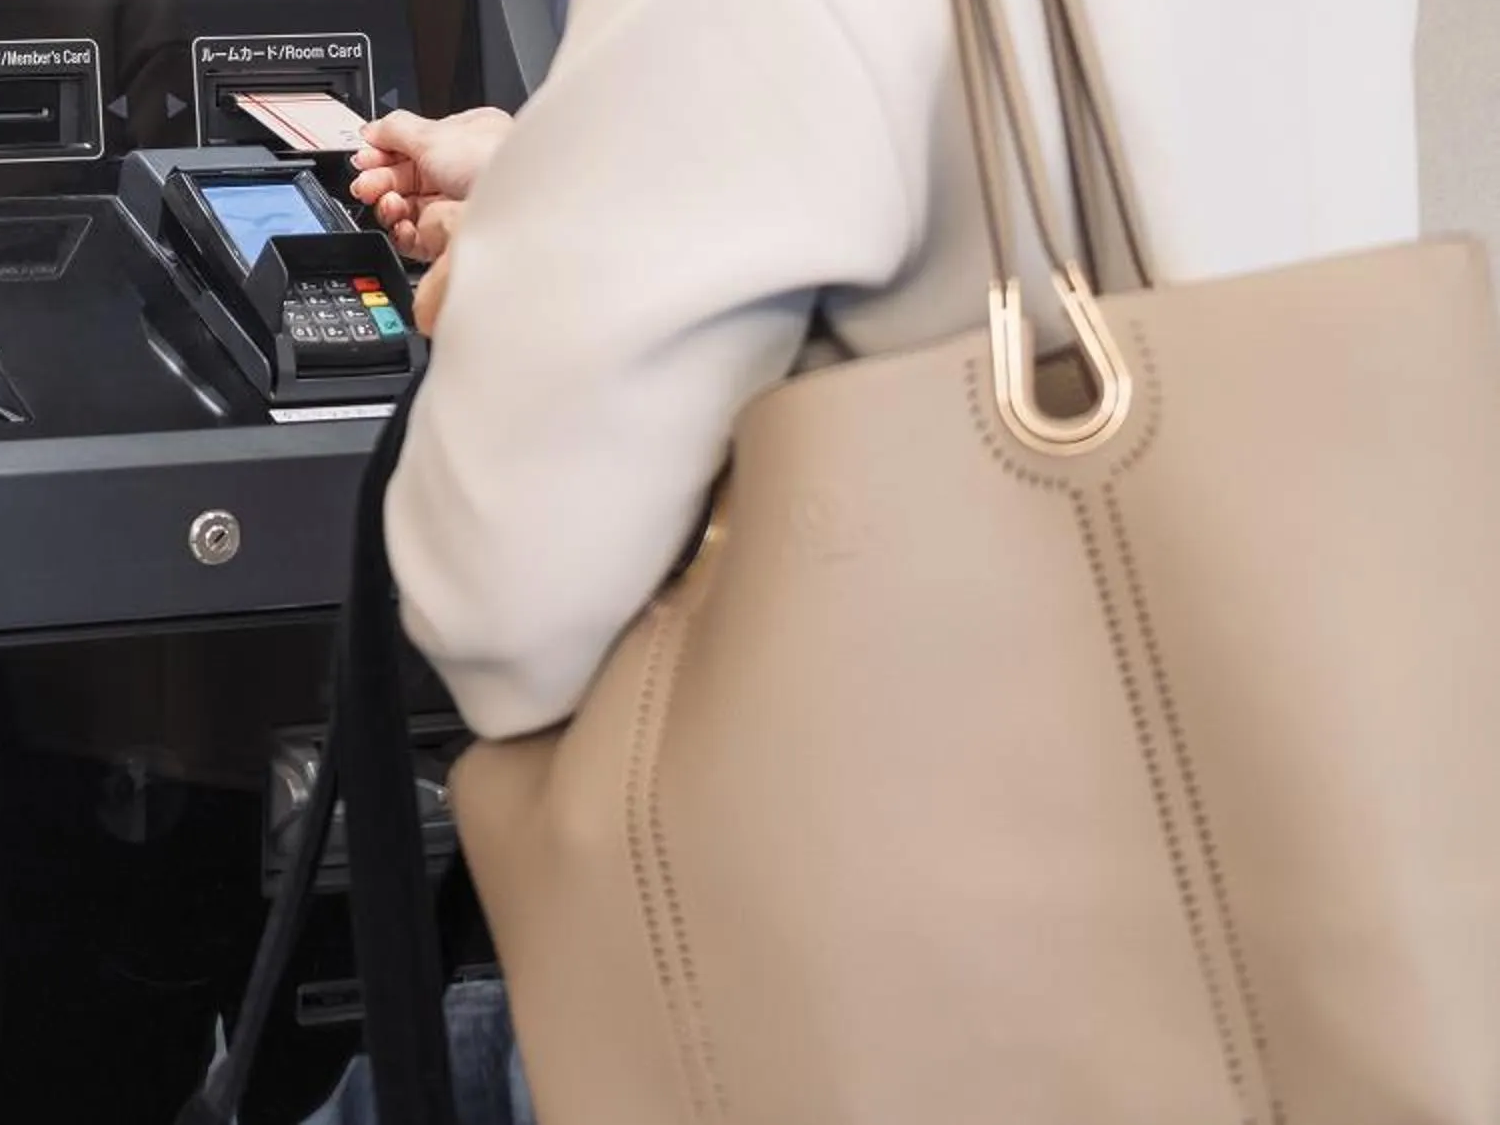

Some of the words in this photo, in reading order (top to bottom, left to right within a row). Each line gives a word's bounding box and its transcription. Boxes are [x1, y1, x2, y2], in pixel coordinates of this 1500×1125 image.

[63, 49, 92, 65] Card
[201, 44, 325, 63] ルームカード/Room
[327, 42, 363, 59] Card
